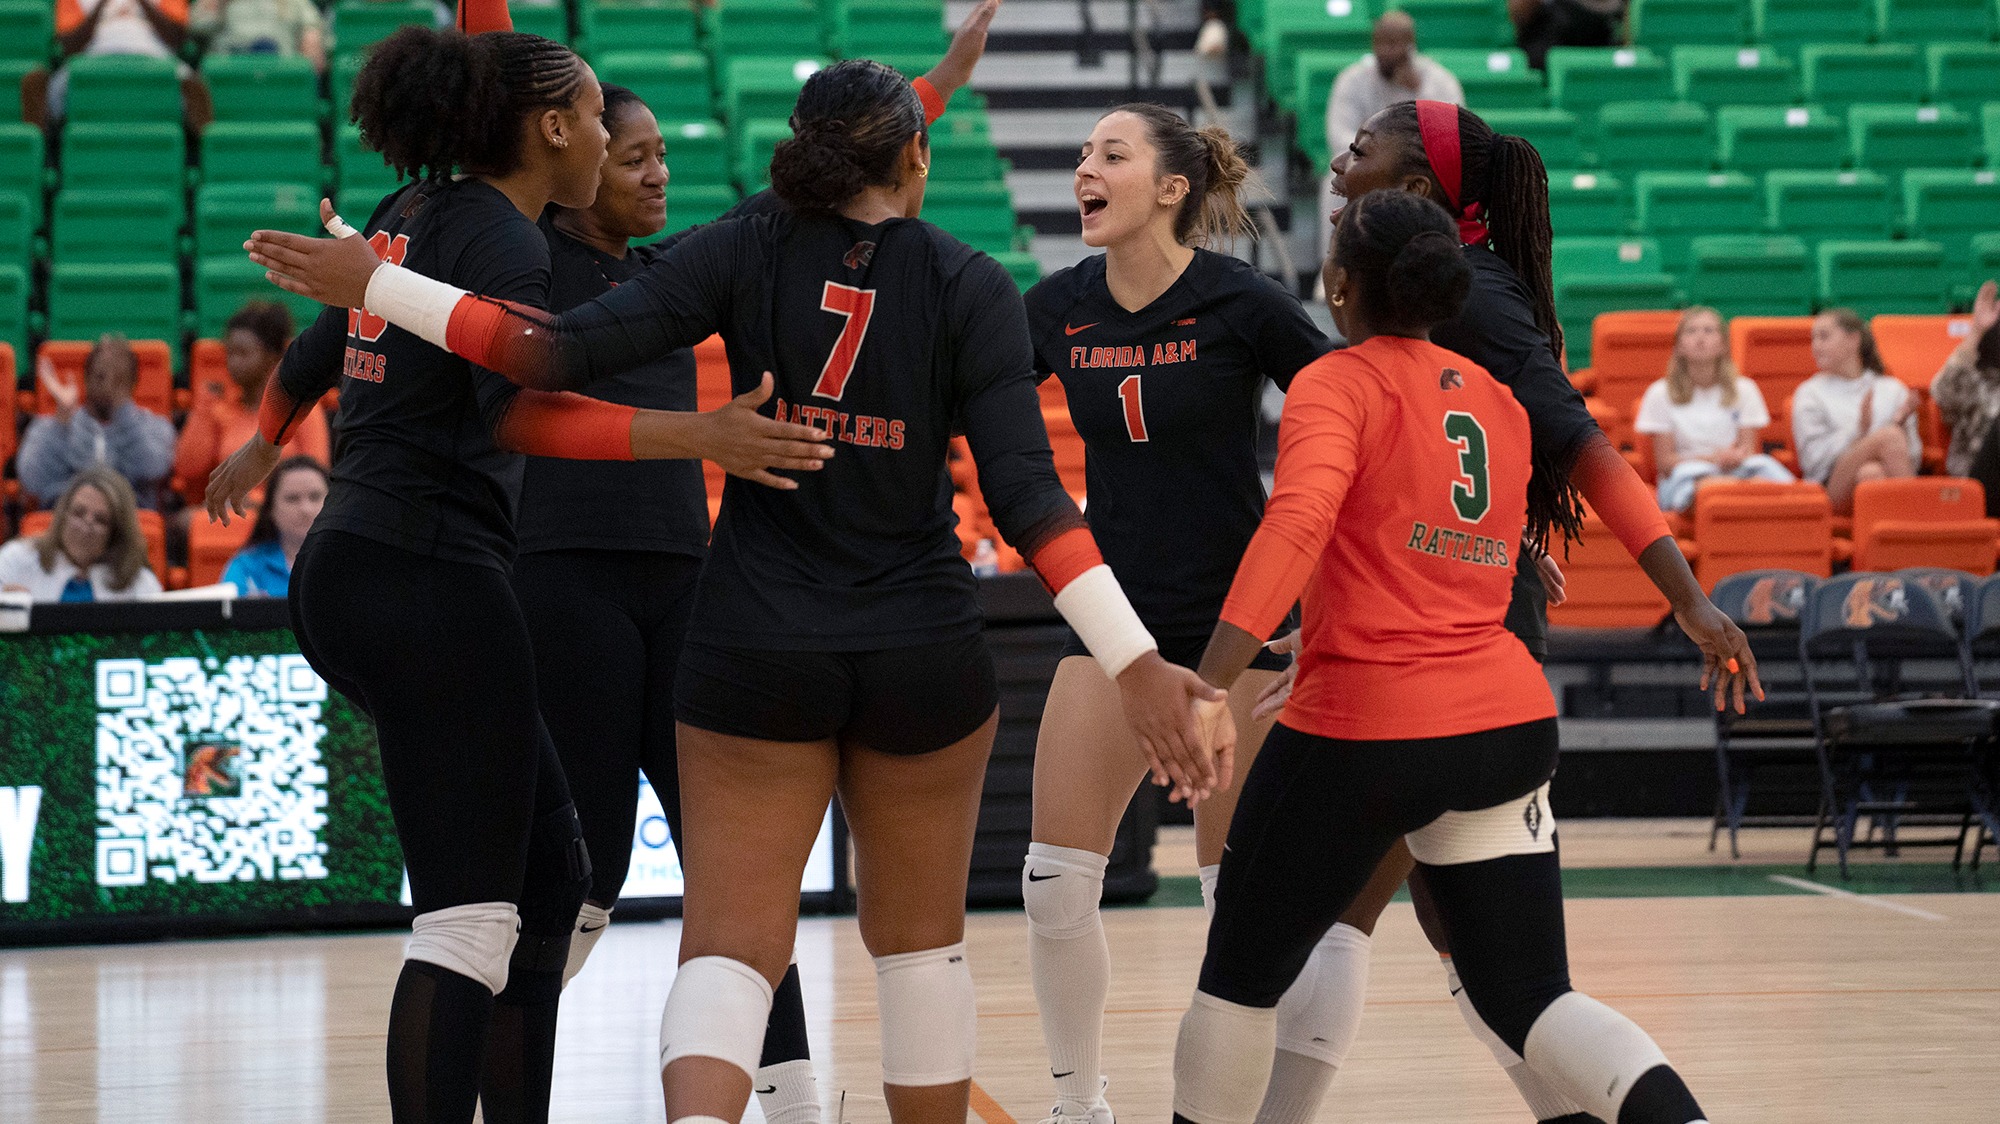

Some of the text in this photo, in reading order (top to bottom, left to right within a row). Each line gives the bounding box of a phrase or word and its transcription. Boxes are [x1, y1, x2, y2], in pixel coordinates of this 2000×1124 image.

[811, 280, 876, 402] 7
[1070, 339, 1197, 369] FLORIDA A&M
[1117, 374, 1149, 442] 1
[1442, 410, 1491, 524] 3
[1407, 521, 1510, 568] RATTLERS
